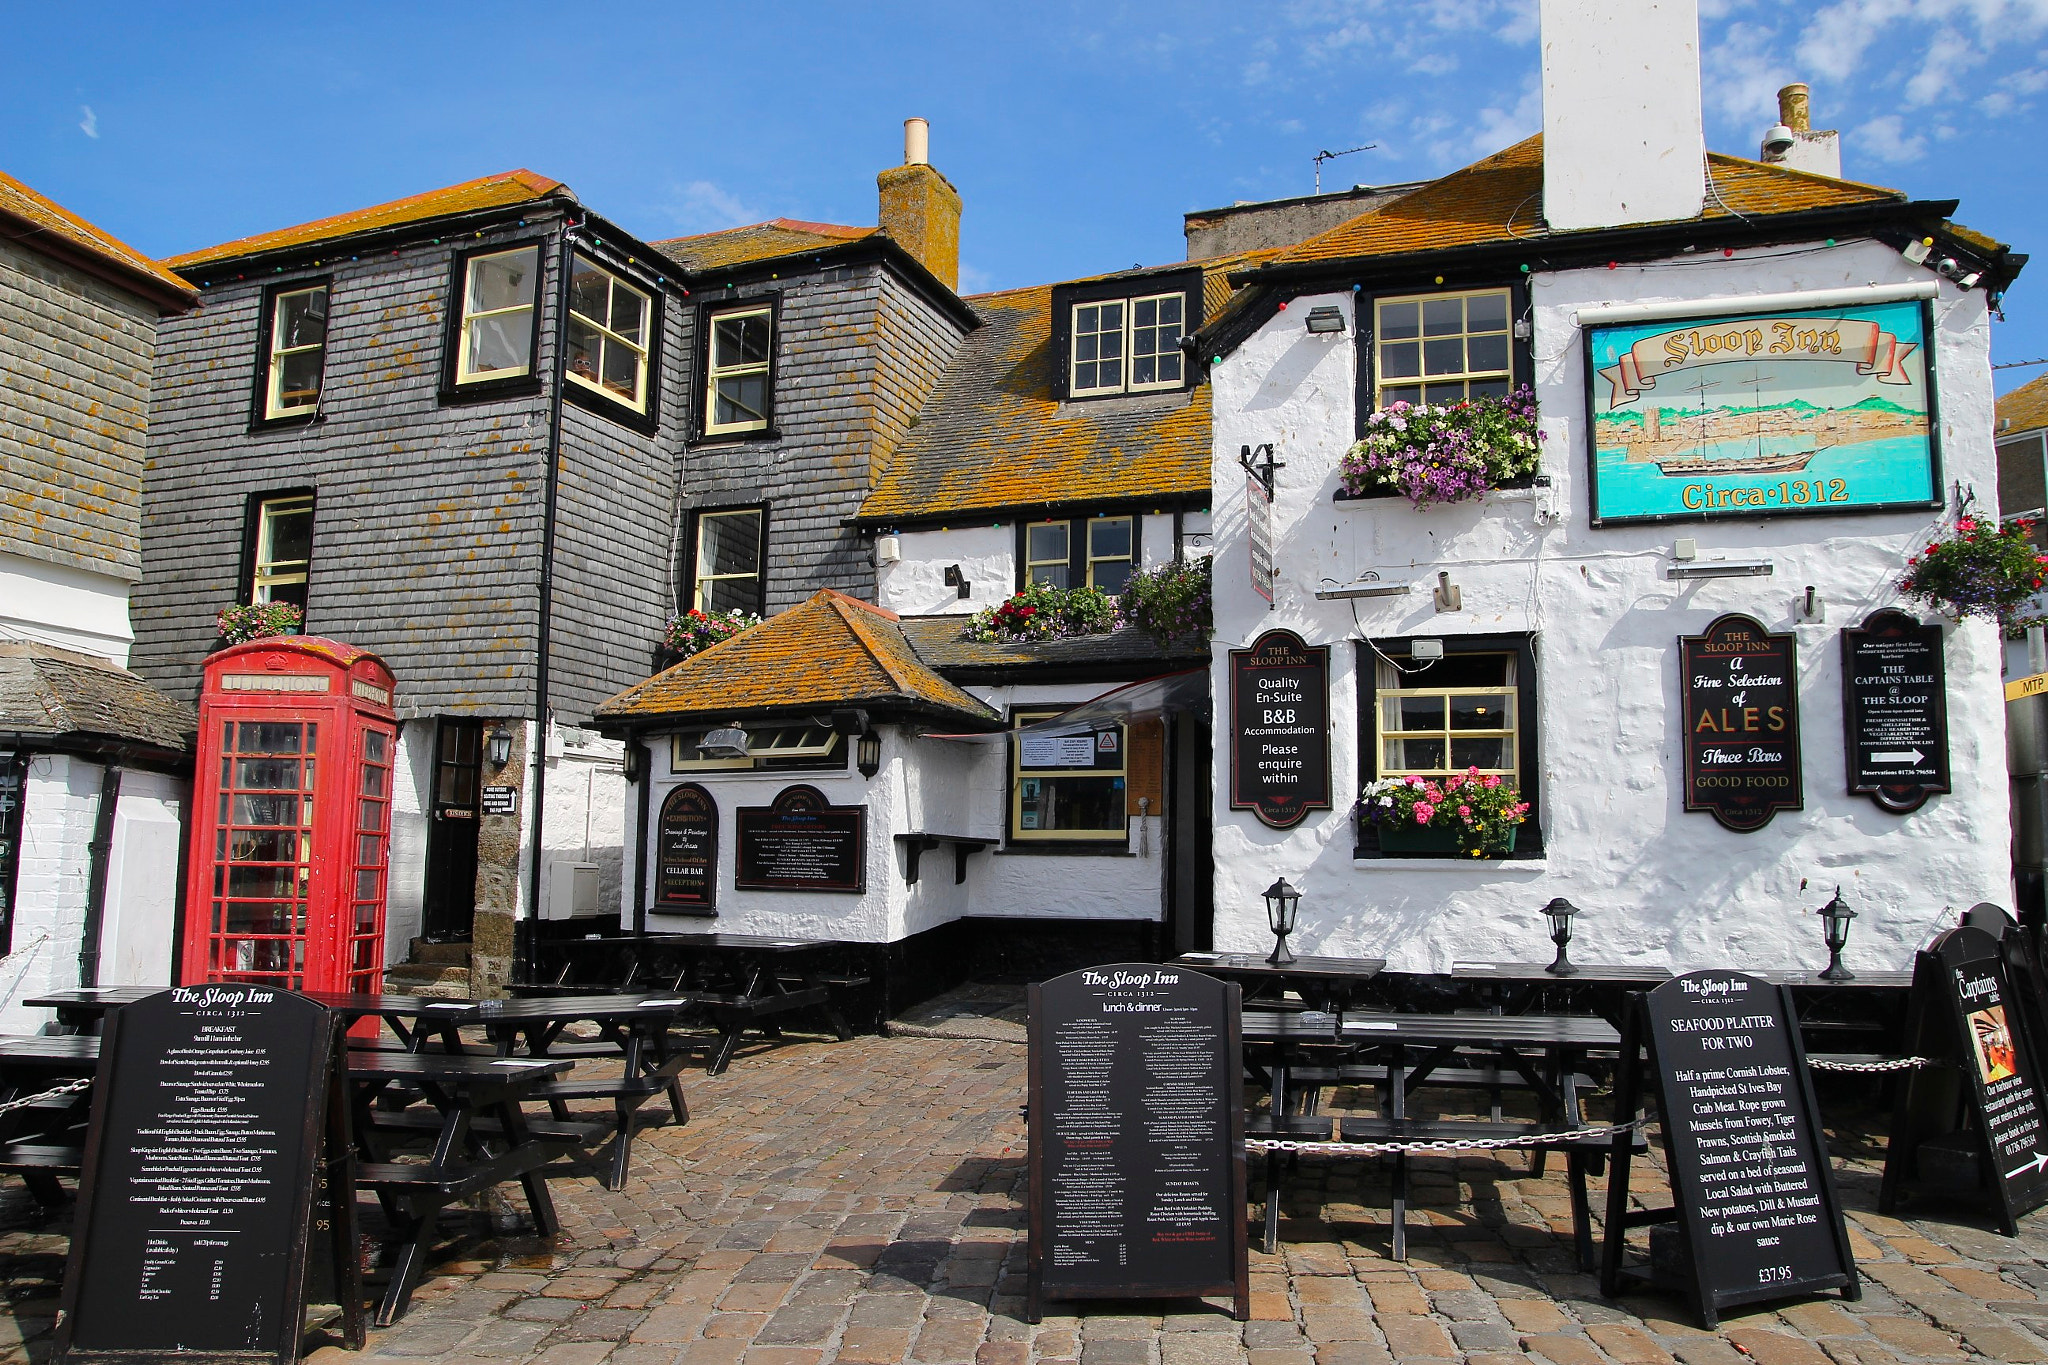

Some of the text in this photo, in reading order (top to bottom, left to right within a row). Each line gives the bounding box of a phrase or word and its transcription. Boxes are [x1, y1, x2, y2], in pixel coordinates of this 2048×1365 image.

[1664, 322, 1841, 367] Sloop Inn
[1725, 632, 1750, 641] THE
[1268, 647, 1289, 655] THE
[1705, 642, 1770, 652] SLOOP INN
[1251, 656, 1306, 665] SLOOP INN
[229, 676, 327, 691] TELEPHONE
[1259, 677, 1299, 689] Quality
[1693, 674, 1782, 688] Fine Selection
[1855, 675, 1934, 684] CAPTAINS TABLE
[2023, 677, 2044, 693] MTP
[353, 680, 387, 703] TELEPHONE
[1256, 692, 1302, 703] En-Suite
[1732, 691, 1746, 707] of
[1889, 686, 1900, 696] @
[1889, 696, 1928, 704] SLOOP
[1264, 709, 1296, 724] B&B
[1696, 706, 1786, 733] ALES
[1244, 726, 1315, 735] Accommodation
[1262, 744, 1298, 754] Please
[1702, 748, 1782, 764] Three Bars
[1259, 759, 1302, 771] enquire
[1262, 773, 1298, 783] within
[1697, 776, 1789, 787] GOOD FOOD
[1082, 971, 1178, 989] The Sloop Inn
[1681, 979, 1748, 996] The Sloop Inn
[1959, 973, 1997, 1002] Captains
[172, 988, 273, 1007] The Sloop Inn
[1103, 1003, 1125, 1012] lunch
[1127, 1003, 1134, 1011] &
[1135, 1002, 1161, 1011] dinner
[1671, 1016, 1775, 1032] SEAFOOD PLATTER
[1701, 1036, 1752, 1050] FOR TWO
[1676, 1070, 1694, 1081] Half
[1702, 1069, 1725, 1082] prime
[1727, 1066, 1757, 1078] Cornish
[1758, 1065, 1790, 1076] Lobster,
[1689, 1082, 1782, 1098] Handpicked St Ives Bay
[1987, 1076, 2022, 1096] Our harbour view
[1693, 1100, 1786, 1114] Crab Meat. Rope grown
[1689, 1113, 1795, 1132] Mussels from Fowey, Tiger
[1697, 1129, 1795, 1148] Prawns, Scottish Smoked
[1995, 1119, 2039, 1147] please book in the bar
[1700, 1146, 1797, 1165] Salmon & Crayfish Tails
[1700, 1170, 1726, 1182] served
[1728, 1171, 1739, 1180] on
[1746, 1166, 1762, 1177] bed
[1764, 1165, 1772, 1176] of
[1774, 1162, 1806, 1175] seasonal
[1705, 1178, 1808, 1200] Local Salad with Buttered
[1700, 1194, 1819, 1218] New potatoes, Dill & Mustard
[1711, 1214, 1816, 1237] dip & our own Marie Rose
[1757, 1236, 1779, 1247] sauce
[1759, 1266, 1791, 1282] £37.95
